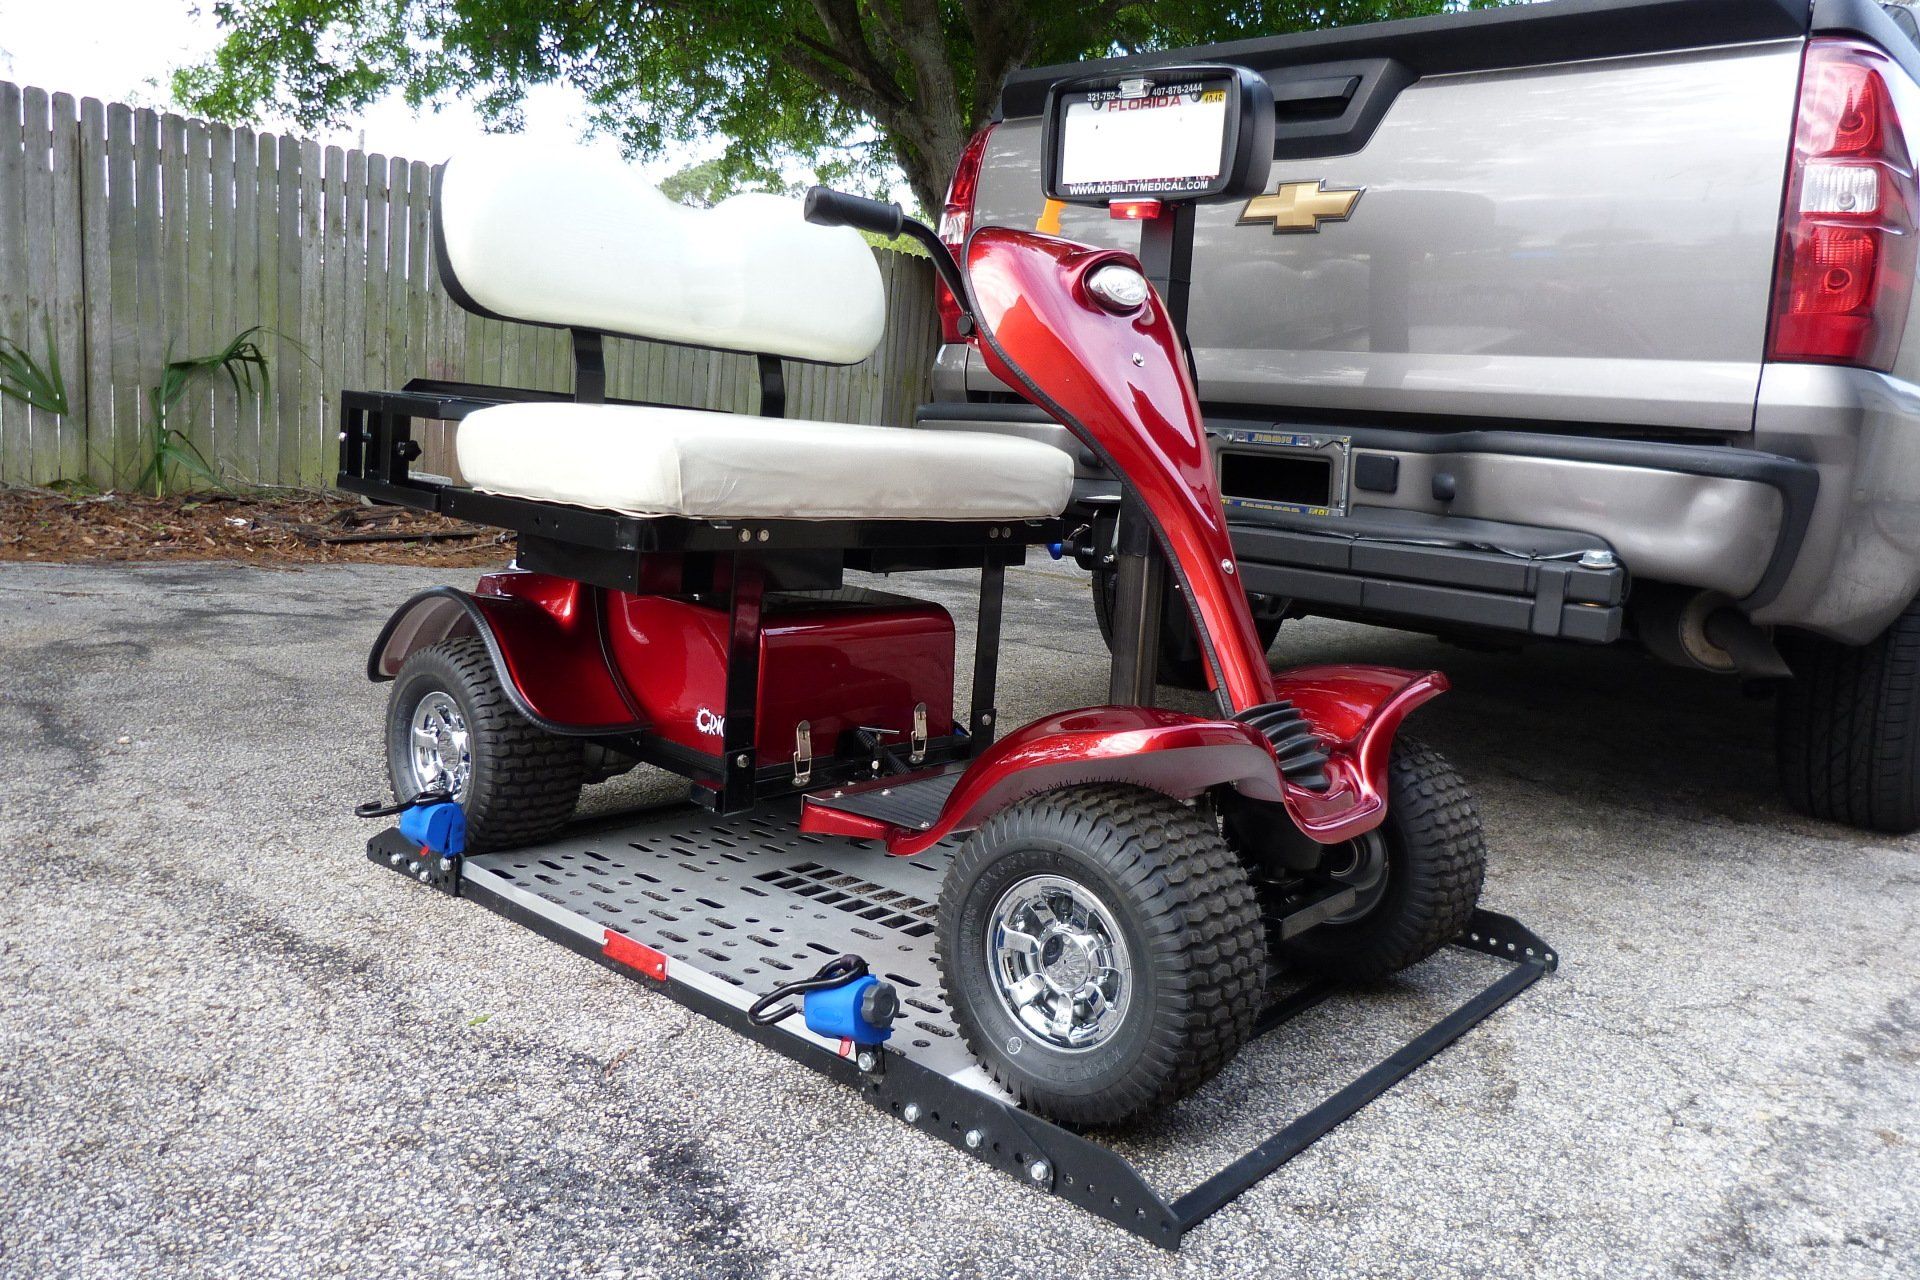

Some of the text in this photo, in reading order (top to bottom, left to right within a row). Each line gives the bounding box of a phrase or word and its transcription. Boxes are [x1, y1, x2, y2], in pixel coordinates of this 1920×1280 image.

[1152, 83, 1202, 96] 407-878-2444
[1087, 92, 1124, 102] 321-752-4
[1108, 96, 1182, 112] FLORIDA
[1069, 180, 1209, 195] WWW.MOBILITYMEDICAL.COM
